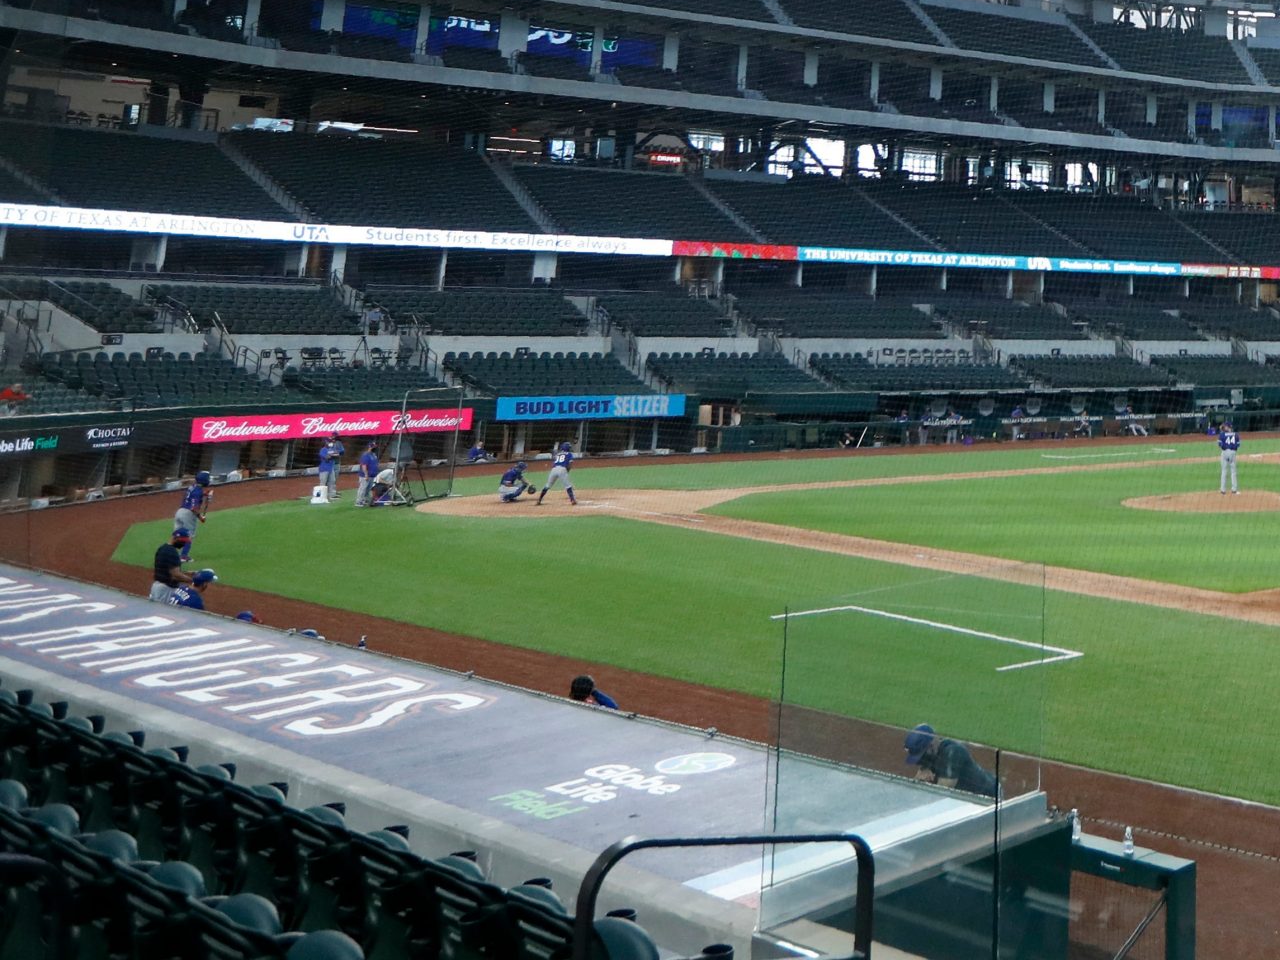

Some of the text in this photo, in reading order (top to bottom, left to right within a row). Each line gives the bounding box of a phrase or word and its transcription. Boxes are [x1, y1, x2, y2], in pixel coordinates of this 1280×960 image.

[34, 210, 58, 223] OF
[66, 212, 123, 228] TEXAS
[129, 215, 149, 228] AT
[156, 217, 256, 235] ARLINGTON
[293, 226, 329, 240] UTA
[366, 228, 440, 244] Students
[445, 230, 481, 245] first.
[491, 233, 573, 249] Excellence
[804, 249, 827, 260] THE
[829, 250, 892, 262] UNIVERSITY
[895, 253, 909, 263] OF
[911, 253, 942, 264] TEXAS
[944, 255, 958, 265] AT
[959, 255, 1015, 268] ARLINGTON
[1027, 257, 1051, 270] UTA
[515, 396, 669, 416] BUD LIGHT SELTZER
[203, 421, 290, 439] Budweiser
[301, 417, 380, 435] Budweiser
[391, 414, 463, 432] Budweiser
[16, 438, 34, 451] Life
[35, 436, 58, 449] Field
[1225, 436, 1235, 444] 44
[0, 615, 487, 737] RANGERS
[584, 764, 681, 795] Globe
[544, 778, 618, 803] Life
[488, 790, 590, 820] Field
